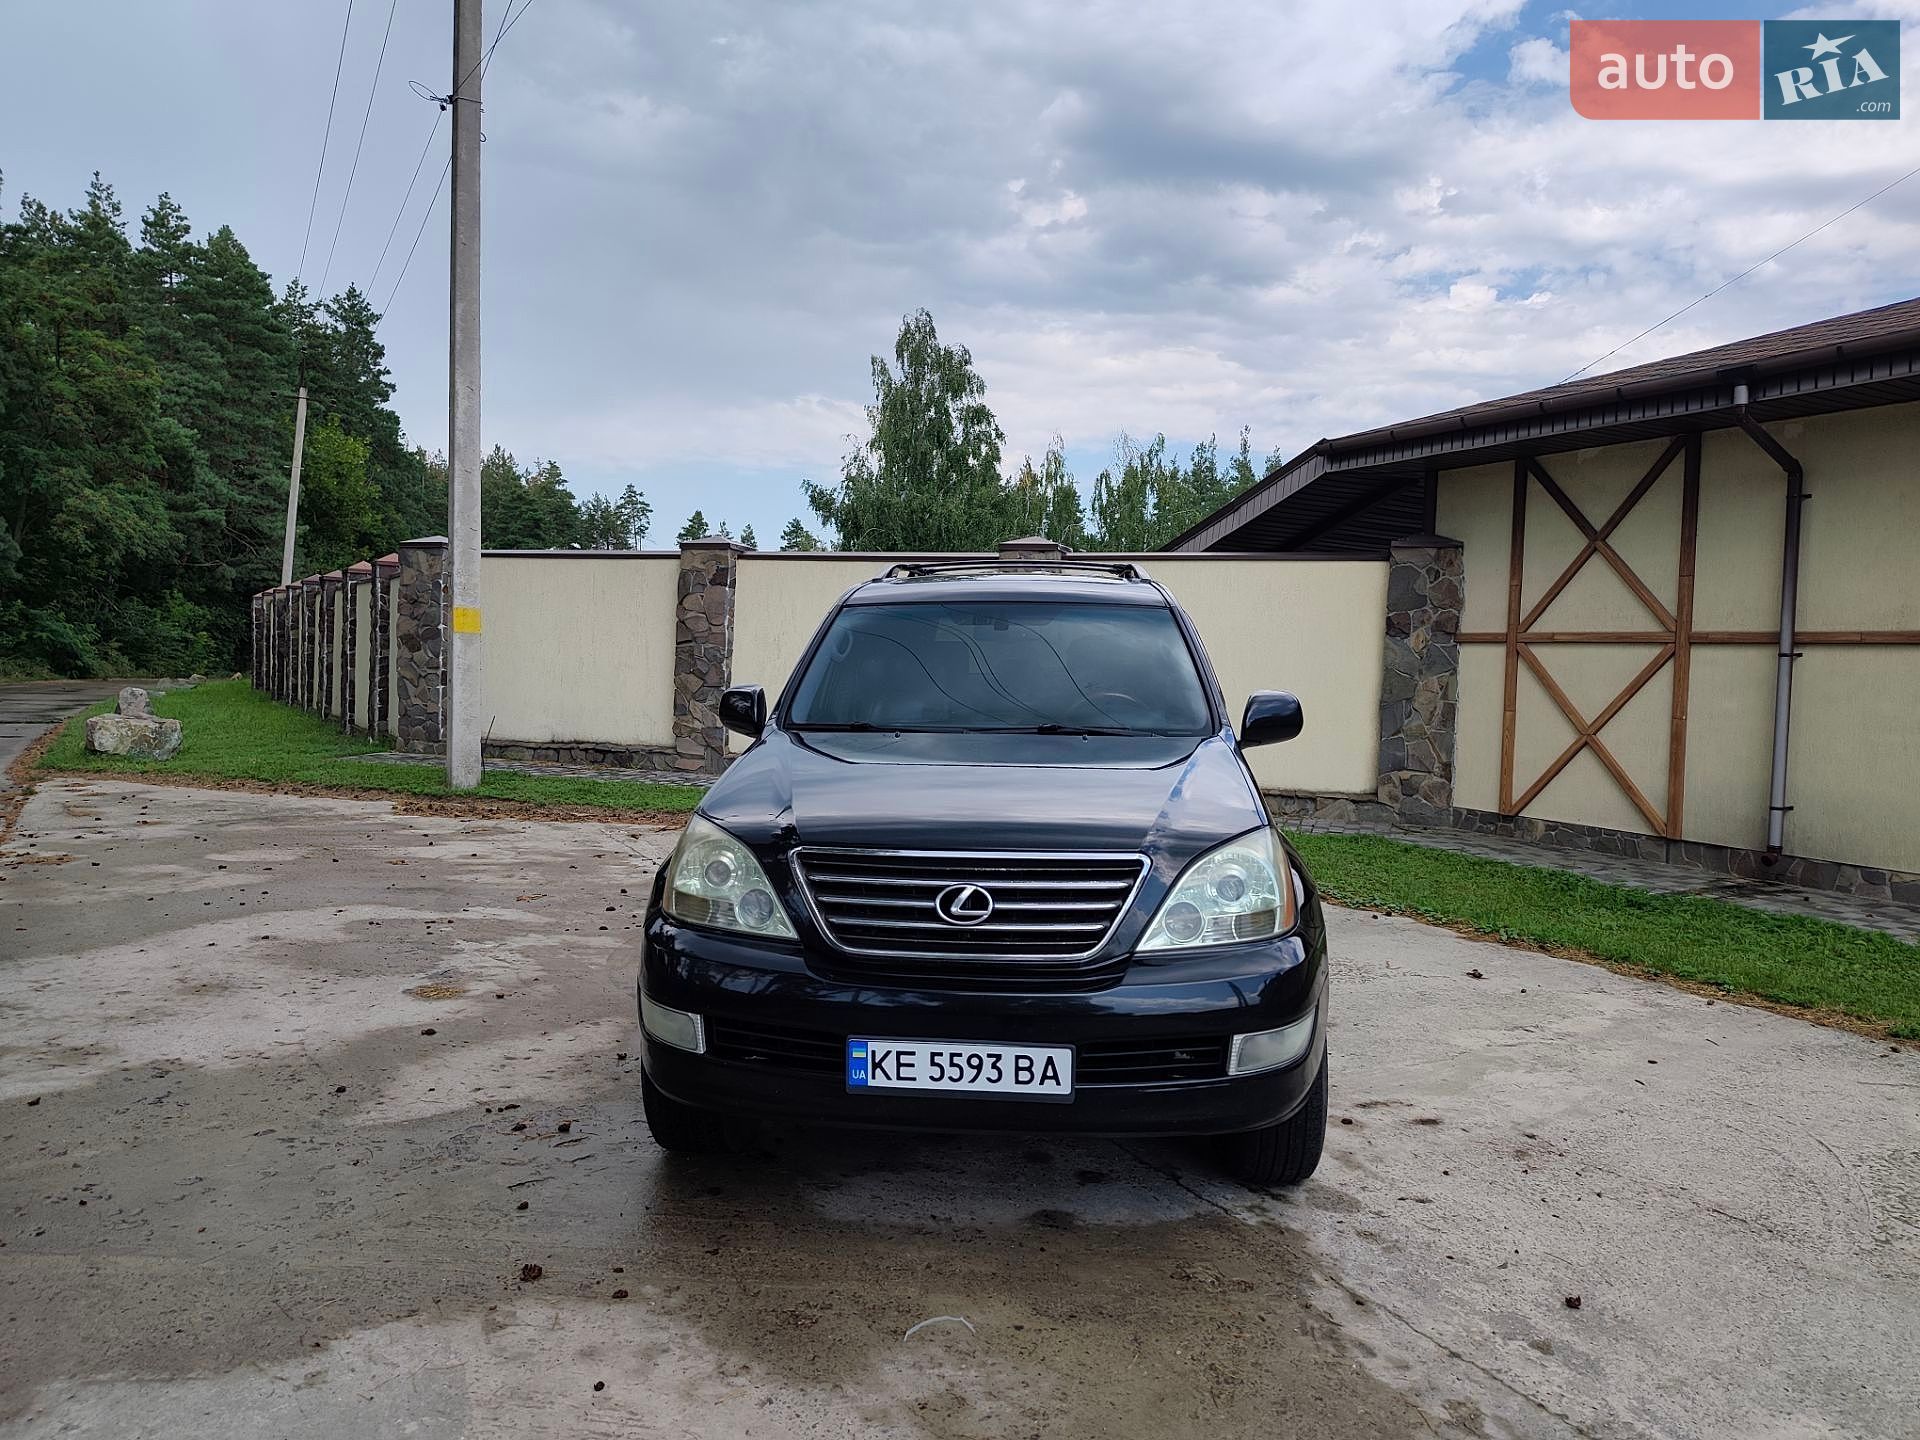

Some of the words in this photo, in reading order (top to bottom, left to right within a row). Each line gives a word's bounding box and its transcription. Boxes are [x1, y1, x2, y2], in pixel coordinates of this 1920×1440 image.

[852, 1069, 866, 1080] UA
[871, 1049, 917, 1081] KE
[928, 1051, 1003, 1084] 5593
[1014, 1055, 1062, 1086] BA
